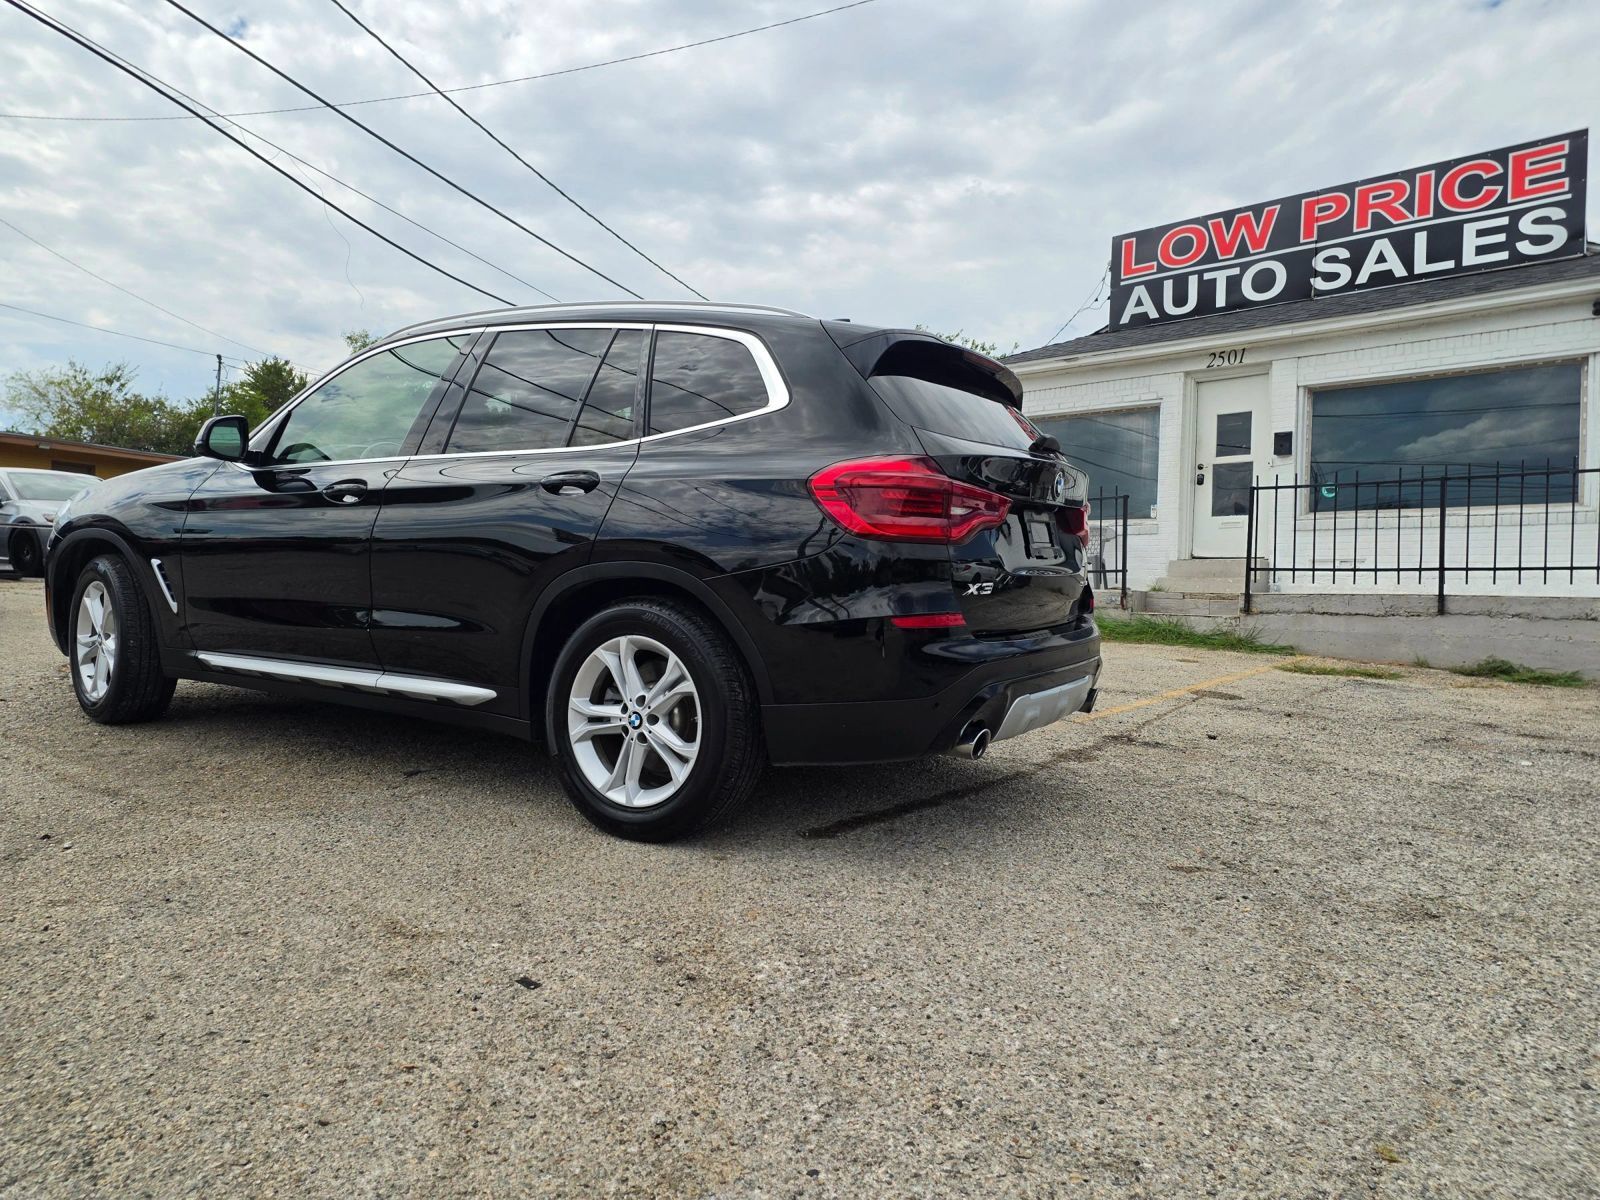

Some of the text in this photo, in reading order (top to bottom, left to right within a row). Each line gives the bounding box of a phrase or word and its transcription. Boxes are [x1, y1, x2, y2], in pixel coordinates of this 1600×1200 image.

[1121, 139, 1570, 279] LOW PRICE
[1119, 206, 1569, 324] AUTO SALES
[1206, 347, 1246, 368] 2501
[962, 582, 994, 596] X3
